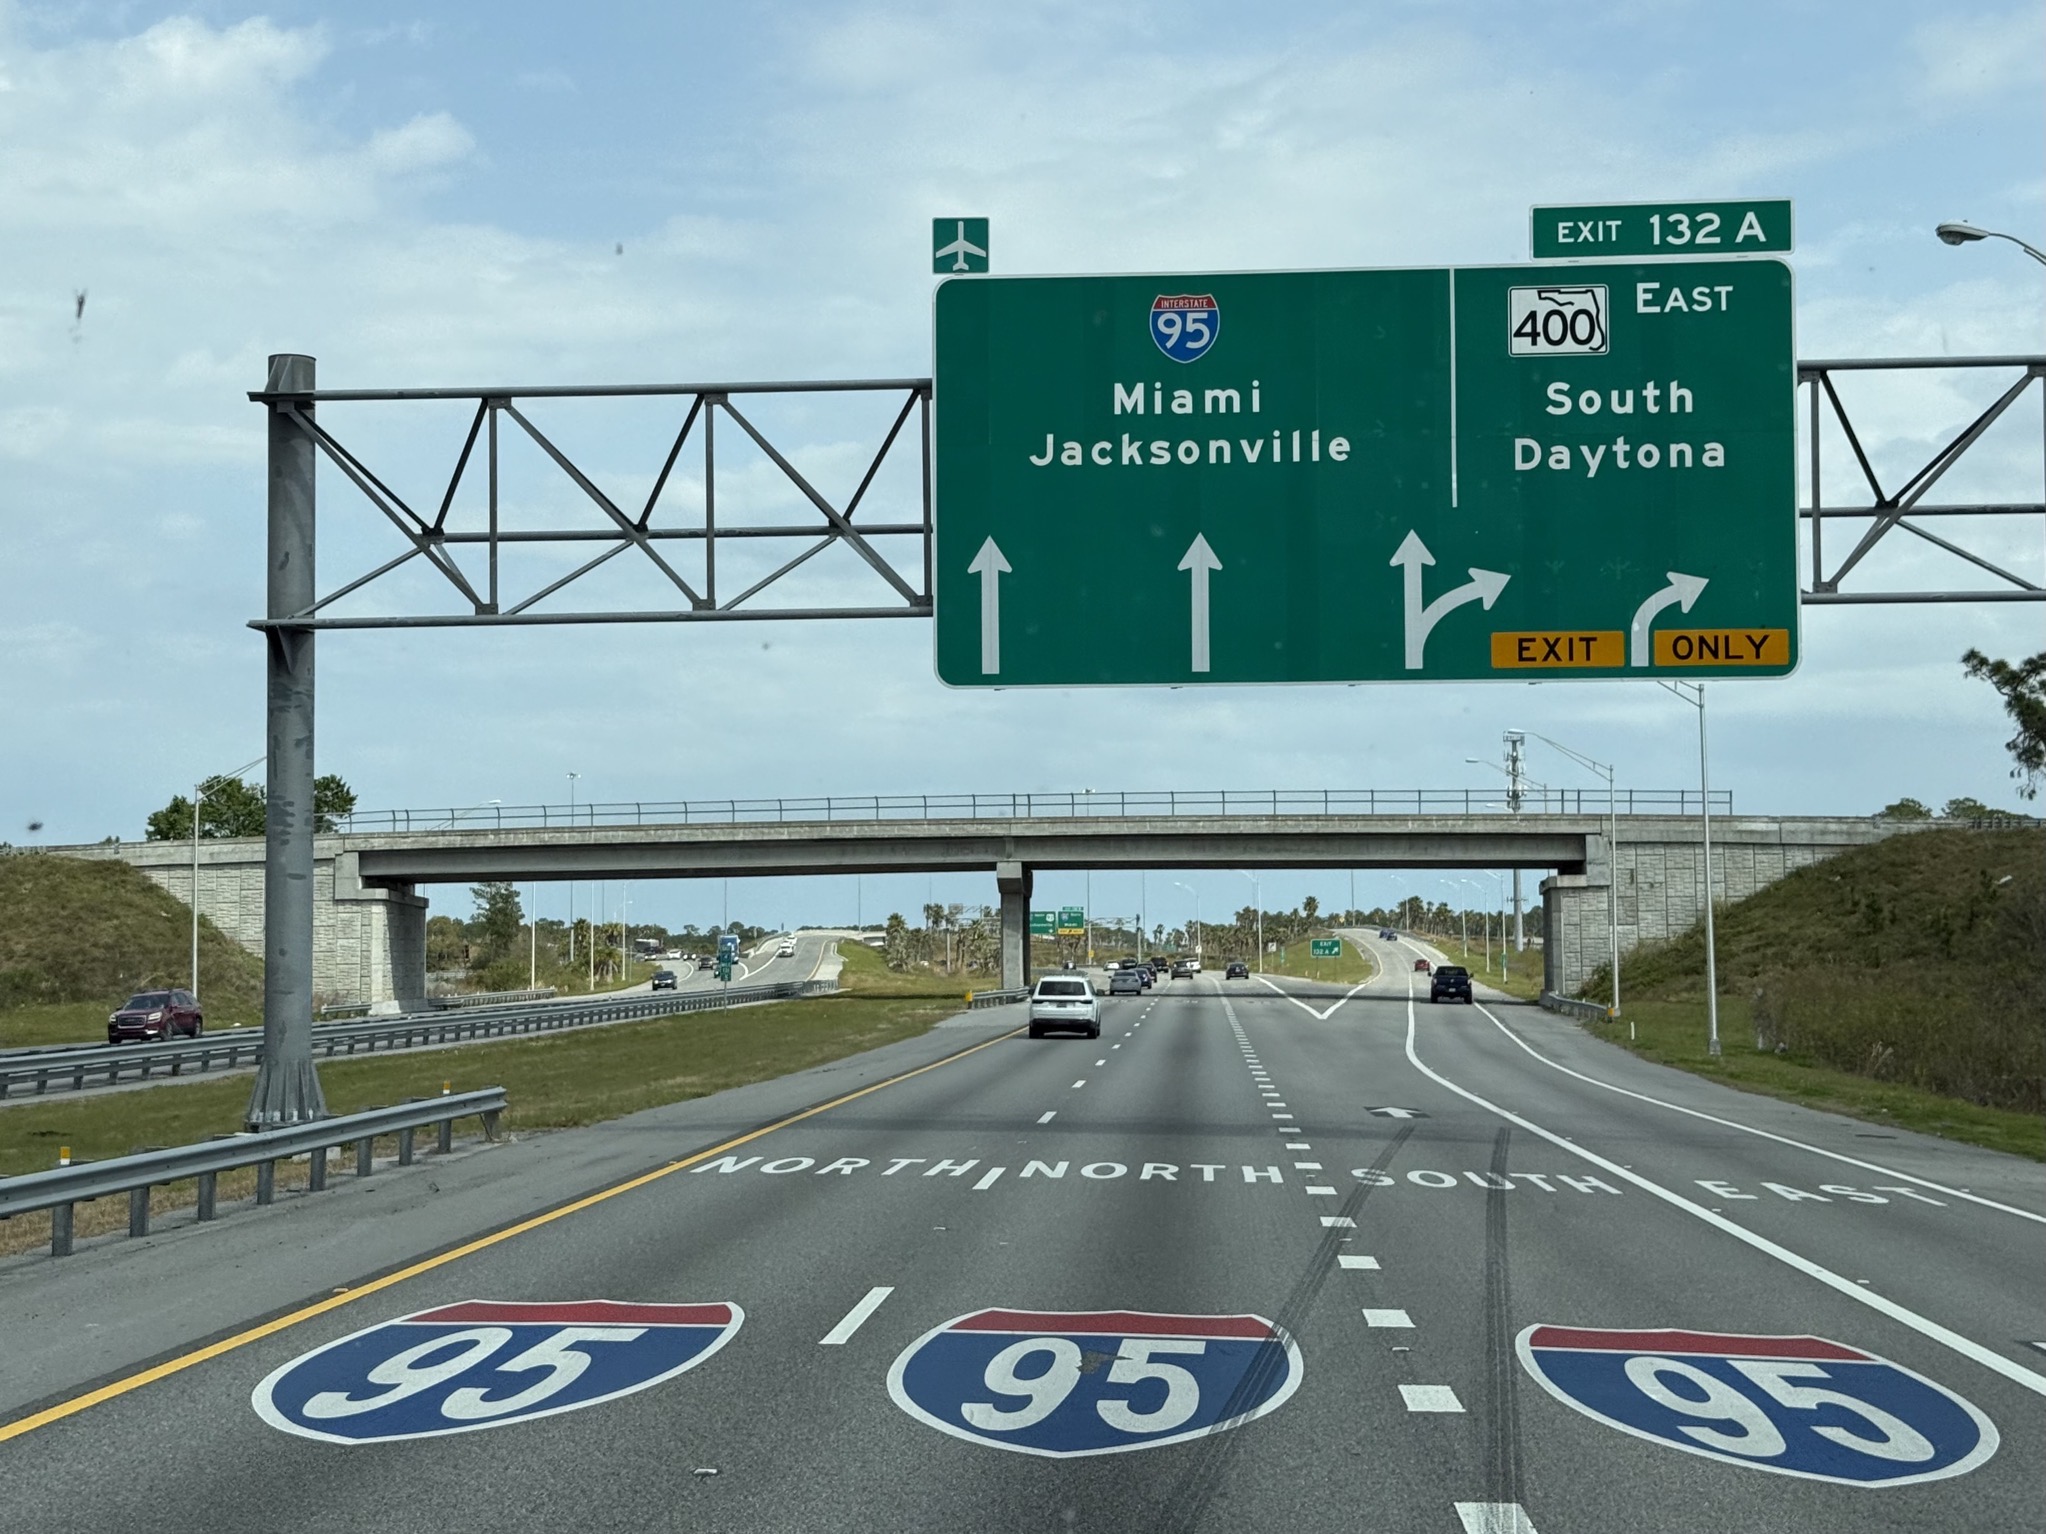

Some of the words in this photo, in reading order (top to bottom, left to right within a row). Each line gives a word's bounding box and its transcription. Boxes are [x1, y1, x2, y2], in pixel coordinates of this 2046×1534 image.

[1557, 220, 1622, 243] EXIT
[1649, 213, 1721, 245] 132
[1735, 212, 1767, 243] A
[1161, 299, 1208, 308] INTERSTATE
[1636, 283, 1734, 314] EAST
[1157, 312, 1211, 350] 95
[1512, 309, 1596, 347] 400
[1113, 380, 1261, 415] Miami
[1545, 380, 1694, 415] South
[1029, 430, 1351, 467] Jacksonville
[1514, 436, 1725, 478] Daytona
[1517, 636, 1598, 662] EXIT
[1672, 635, 1770, 661] ONLY
[689, 1156, 980, 1176] NORTH
[1019, 1160, 1284, 1183] NORTH
[1351, 1168, 1623, 1194] SOUTH
[1694, 1180, 1948, 1206] EAST
[302, 1327, 649, 1420] 95
[960, 1337, 1206, 1433] 95
[1624, 1356, 1935, 1462] 95
